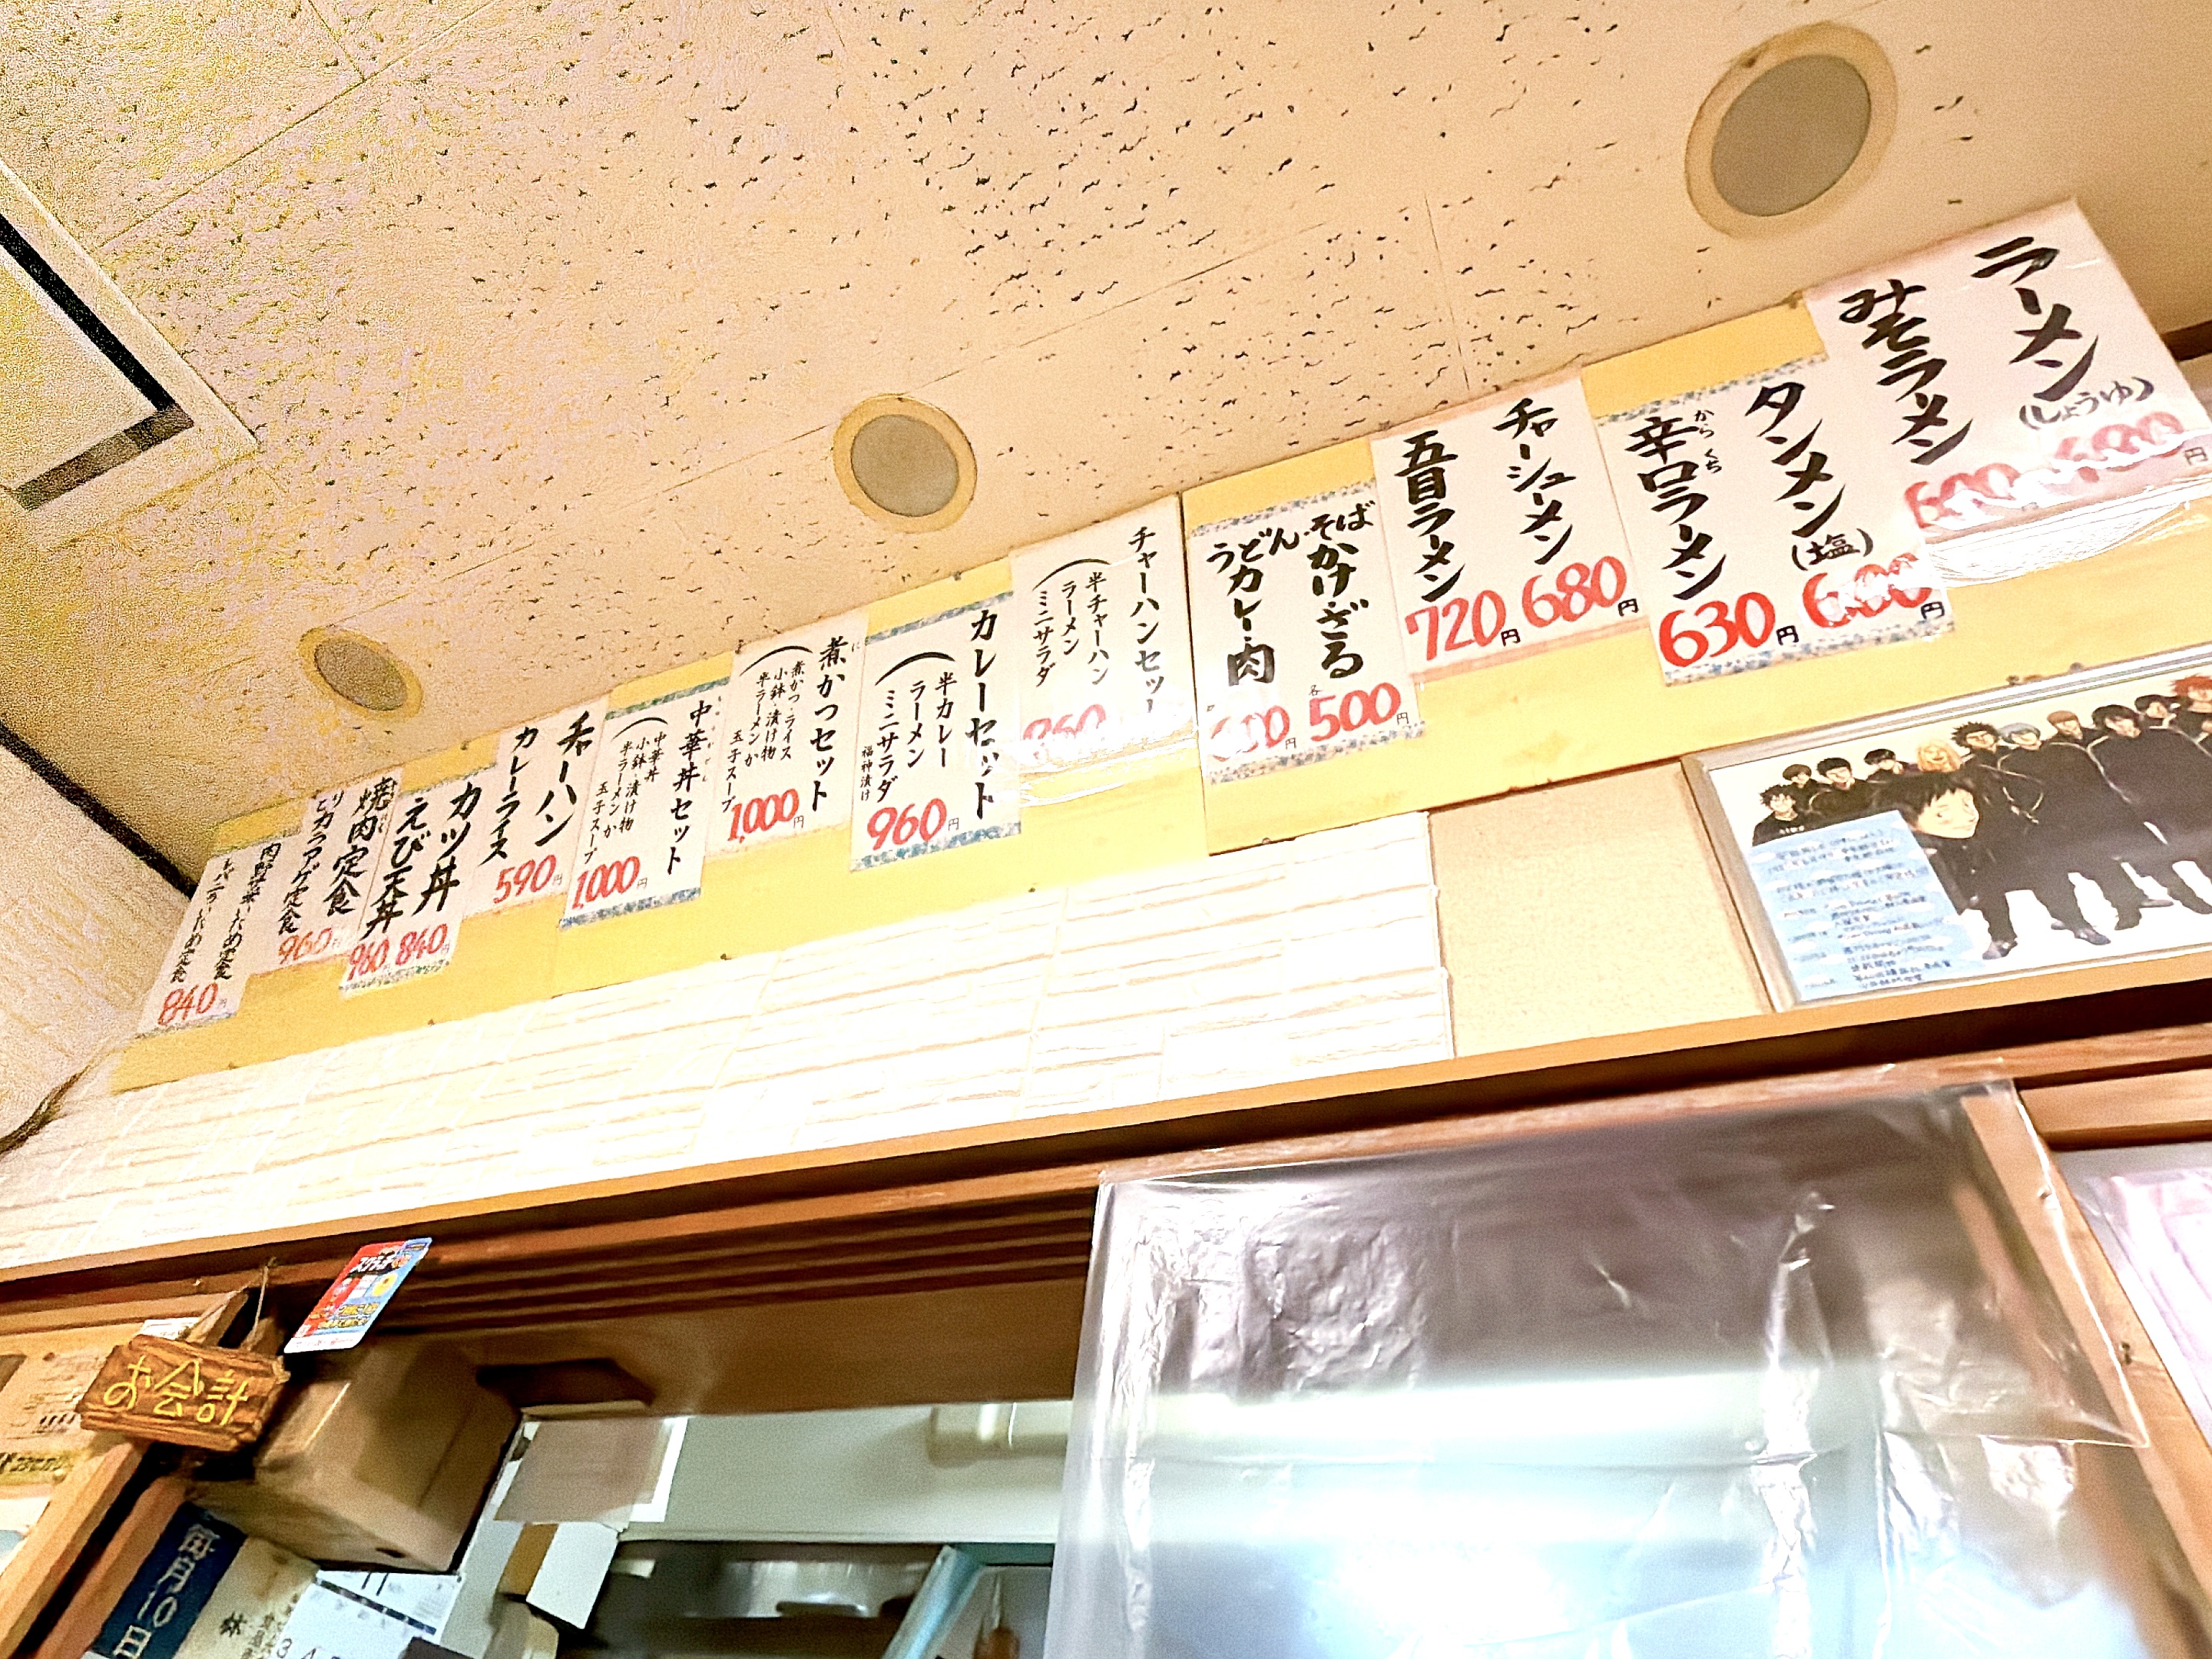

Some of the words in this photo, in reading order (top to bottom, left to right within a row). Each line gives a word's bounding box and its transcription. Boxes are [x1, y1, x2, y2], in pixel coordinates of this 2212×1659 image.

[1839, 279, 1973, 465] みそラーメン
[1971, 237, 2099, 401] ラーメン
[1395, 430, 1465, 602] 五目ラーメン
[1492, 398, 1577, 565] チャーシューメン
[1625, 416, 1727, 601] 辛口ラーメン
[1744, 382, 1846, 538] タンメン
[1061, 581, 1079, 655] ラーメン
[1791, 528, 1873, 571] (塩)
[1033, 591, 1056, 687] ミニサラダ
[1085, 572, 1110, 685] 半チャーハン
[535, 710, 594, 846] チャーハン
[644, 731, 667, 782] 中華丼
[810, 636, 849, 812] 煮かつセット
[876, 690, 899, 803] ミニサラダ
[907, 680, 926, 768] ラーメン
[935, 672, 957, 767] 半カレー
[965, 609, 999, 820] カレーセット
[323, 777, 397, 917] 焼肉定食
[412, 782, 482, 916] カツ丼
[478, 727, 538, 866] カレーライス
[667, 700, 712, 875] 中華丼セット
[359, 797, 431, 940] えび天丼
[104, 1355, 249, 1426] お会計
